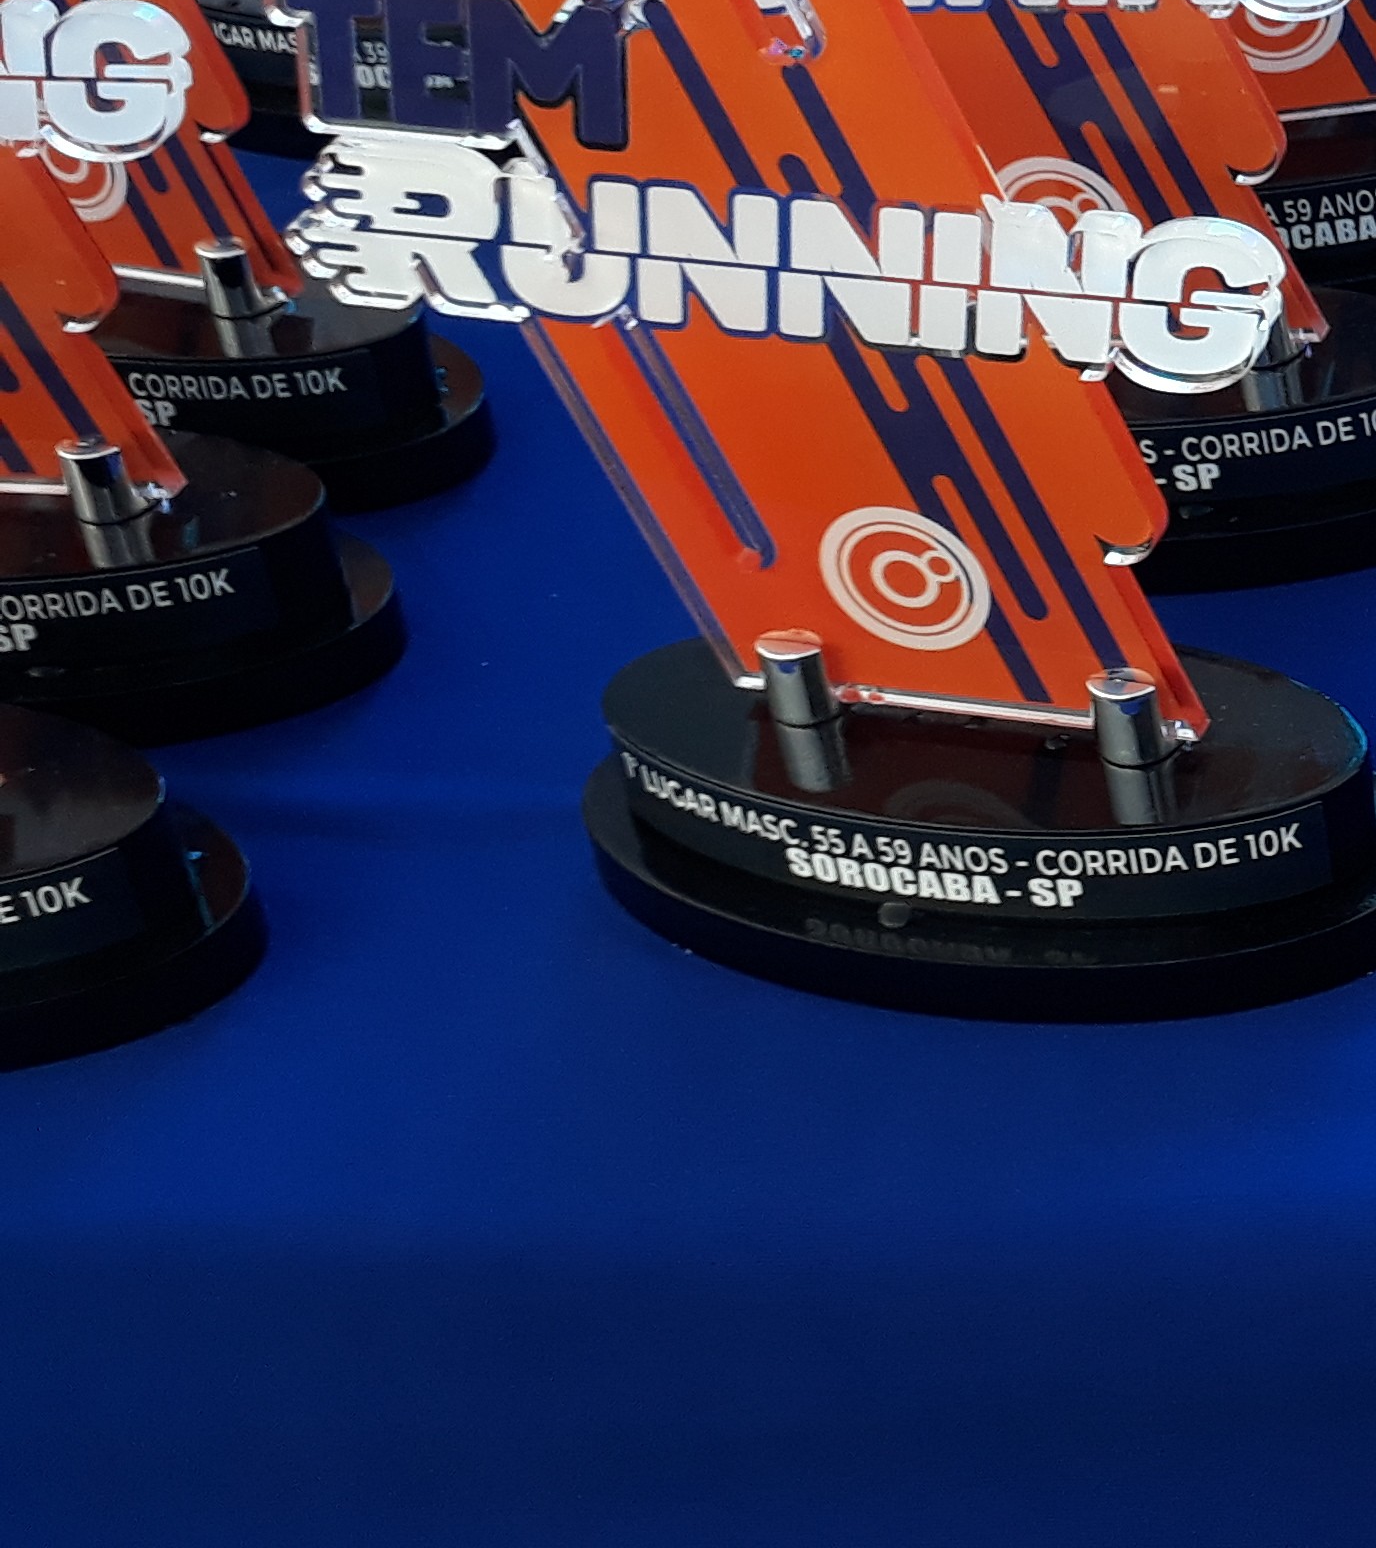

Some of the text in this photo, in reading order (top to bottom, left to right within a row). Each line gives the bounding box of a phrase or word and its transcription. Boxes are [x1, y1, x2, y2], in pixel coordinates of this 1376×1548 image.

[1284, 199, 1313, 225] 59
[295, 140, 1285, 390] RUNNING
[128, 367, 348, 401] CORRIDA DE 10K
[1181, 425, 1313, 462] CORRIDA
[1316, 416, 1357, 447] DE
[1172, 462, 1222, 492] SP
[0, 568, 236, 621] ORRIDA DE 10K
[639, 764, 720, 823] LUGAR
[719, 801, 809, 848] MASC.
[810, 825, 846, 854] 55
[850, 832, 874, 861] A
[876, 836, 912, 866] 59
[919, 842, 1009, 875] ANOS
[1036, 846, 1189, 877] CORRIDA
[1194, 838, 1240, 869] DE
[1245, 822, 1303, 860] 10K
[20, 877, 93, 917] 10K
[785, 847, 1003, 905] SOROCABA
[1028, 878, 1084, 908] SP
